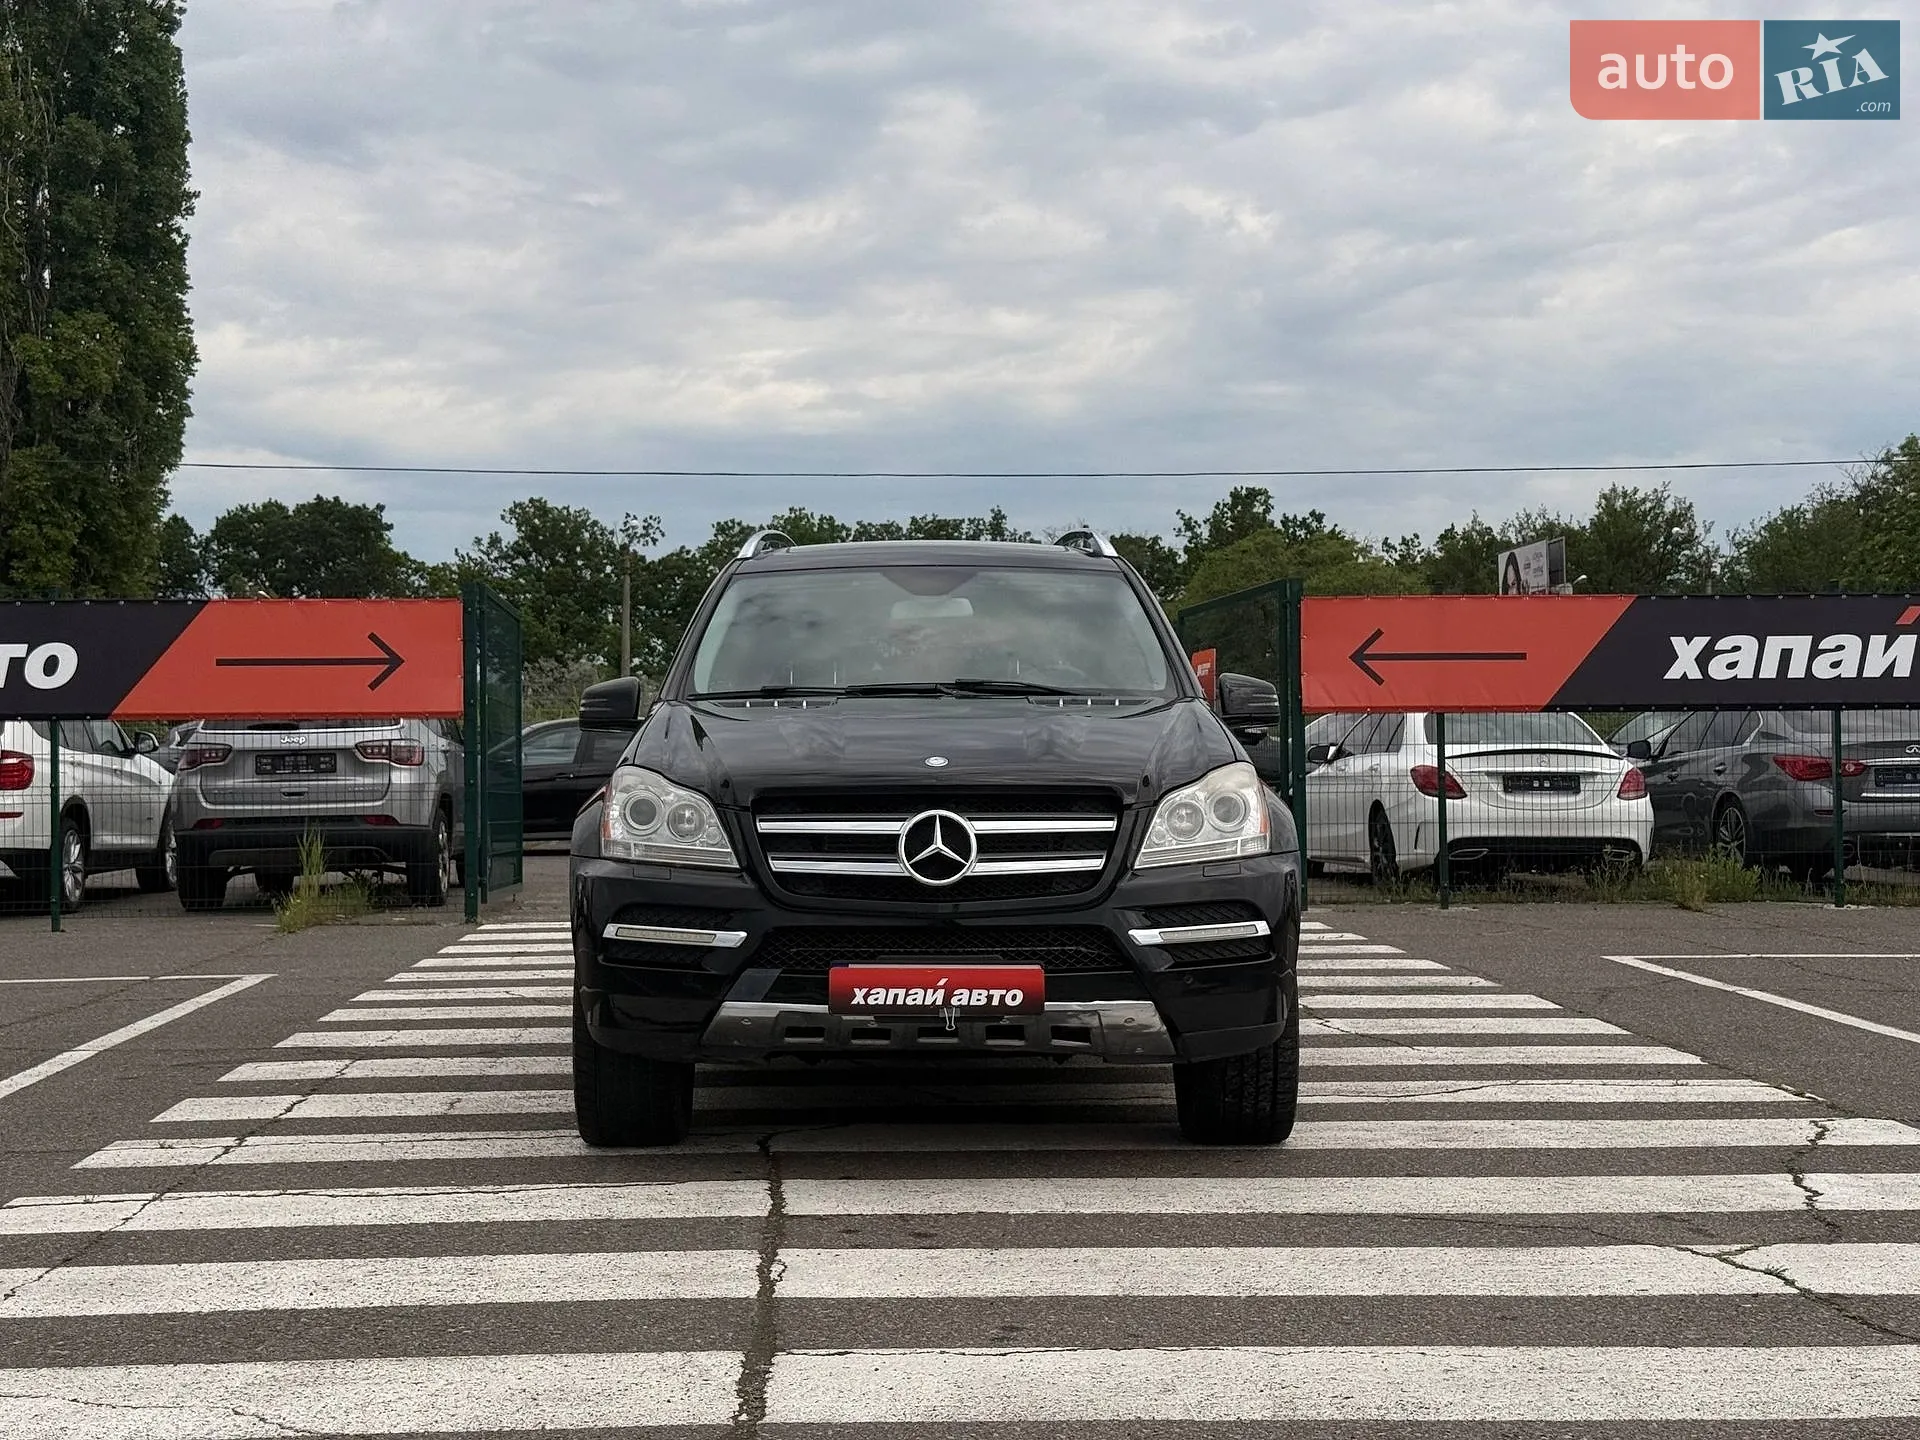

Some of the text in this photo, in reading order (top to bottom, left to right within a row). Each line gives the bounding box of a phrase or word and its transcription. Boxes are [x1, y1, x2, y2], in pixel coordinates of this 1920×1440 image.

[280, 735, 306, 746] Jeep
[851, 978, 1024, 1007] хапай авто
